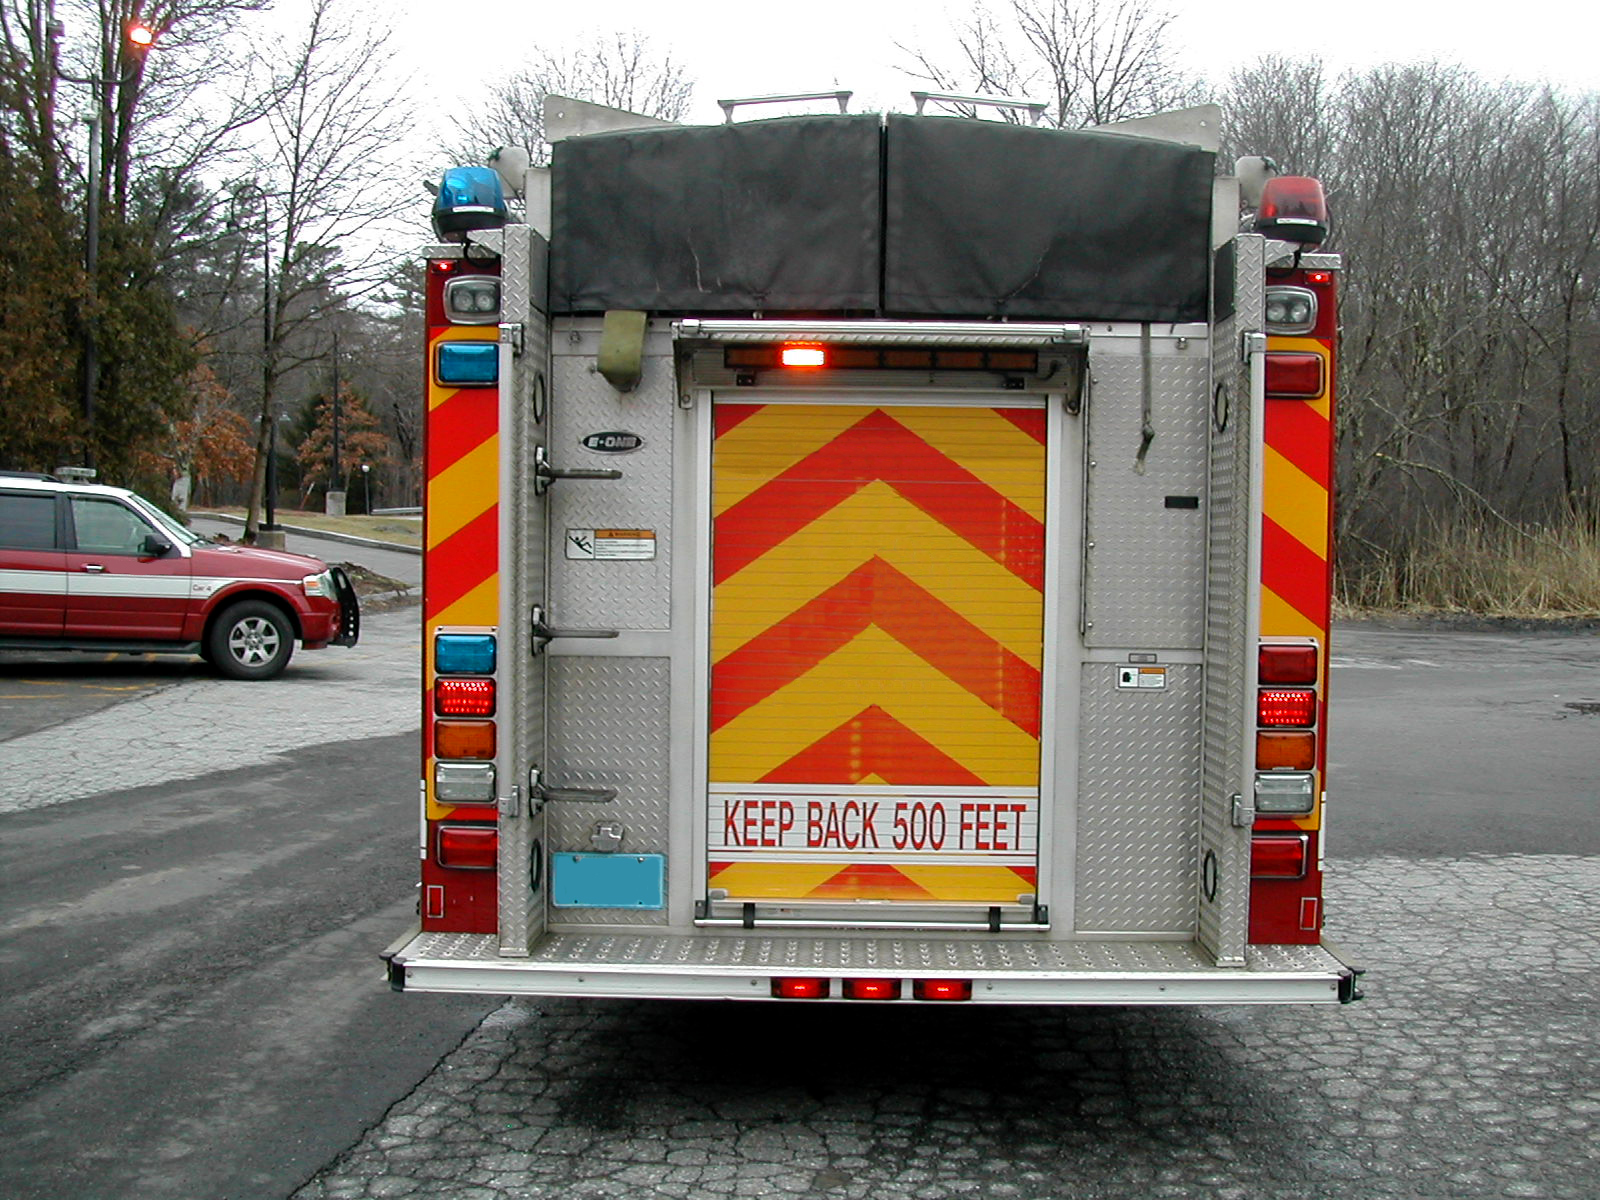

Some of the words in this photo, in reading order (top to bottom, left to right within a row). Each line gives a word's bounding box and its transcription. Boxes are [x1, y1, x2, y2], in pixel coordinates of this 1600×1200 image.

[724, 800, 794, 847] KEEP
[807, 800, 879, 849] BACK
[892, 802, 946, 850] 500
[959, 803, 1027, 849] FEET
